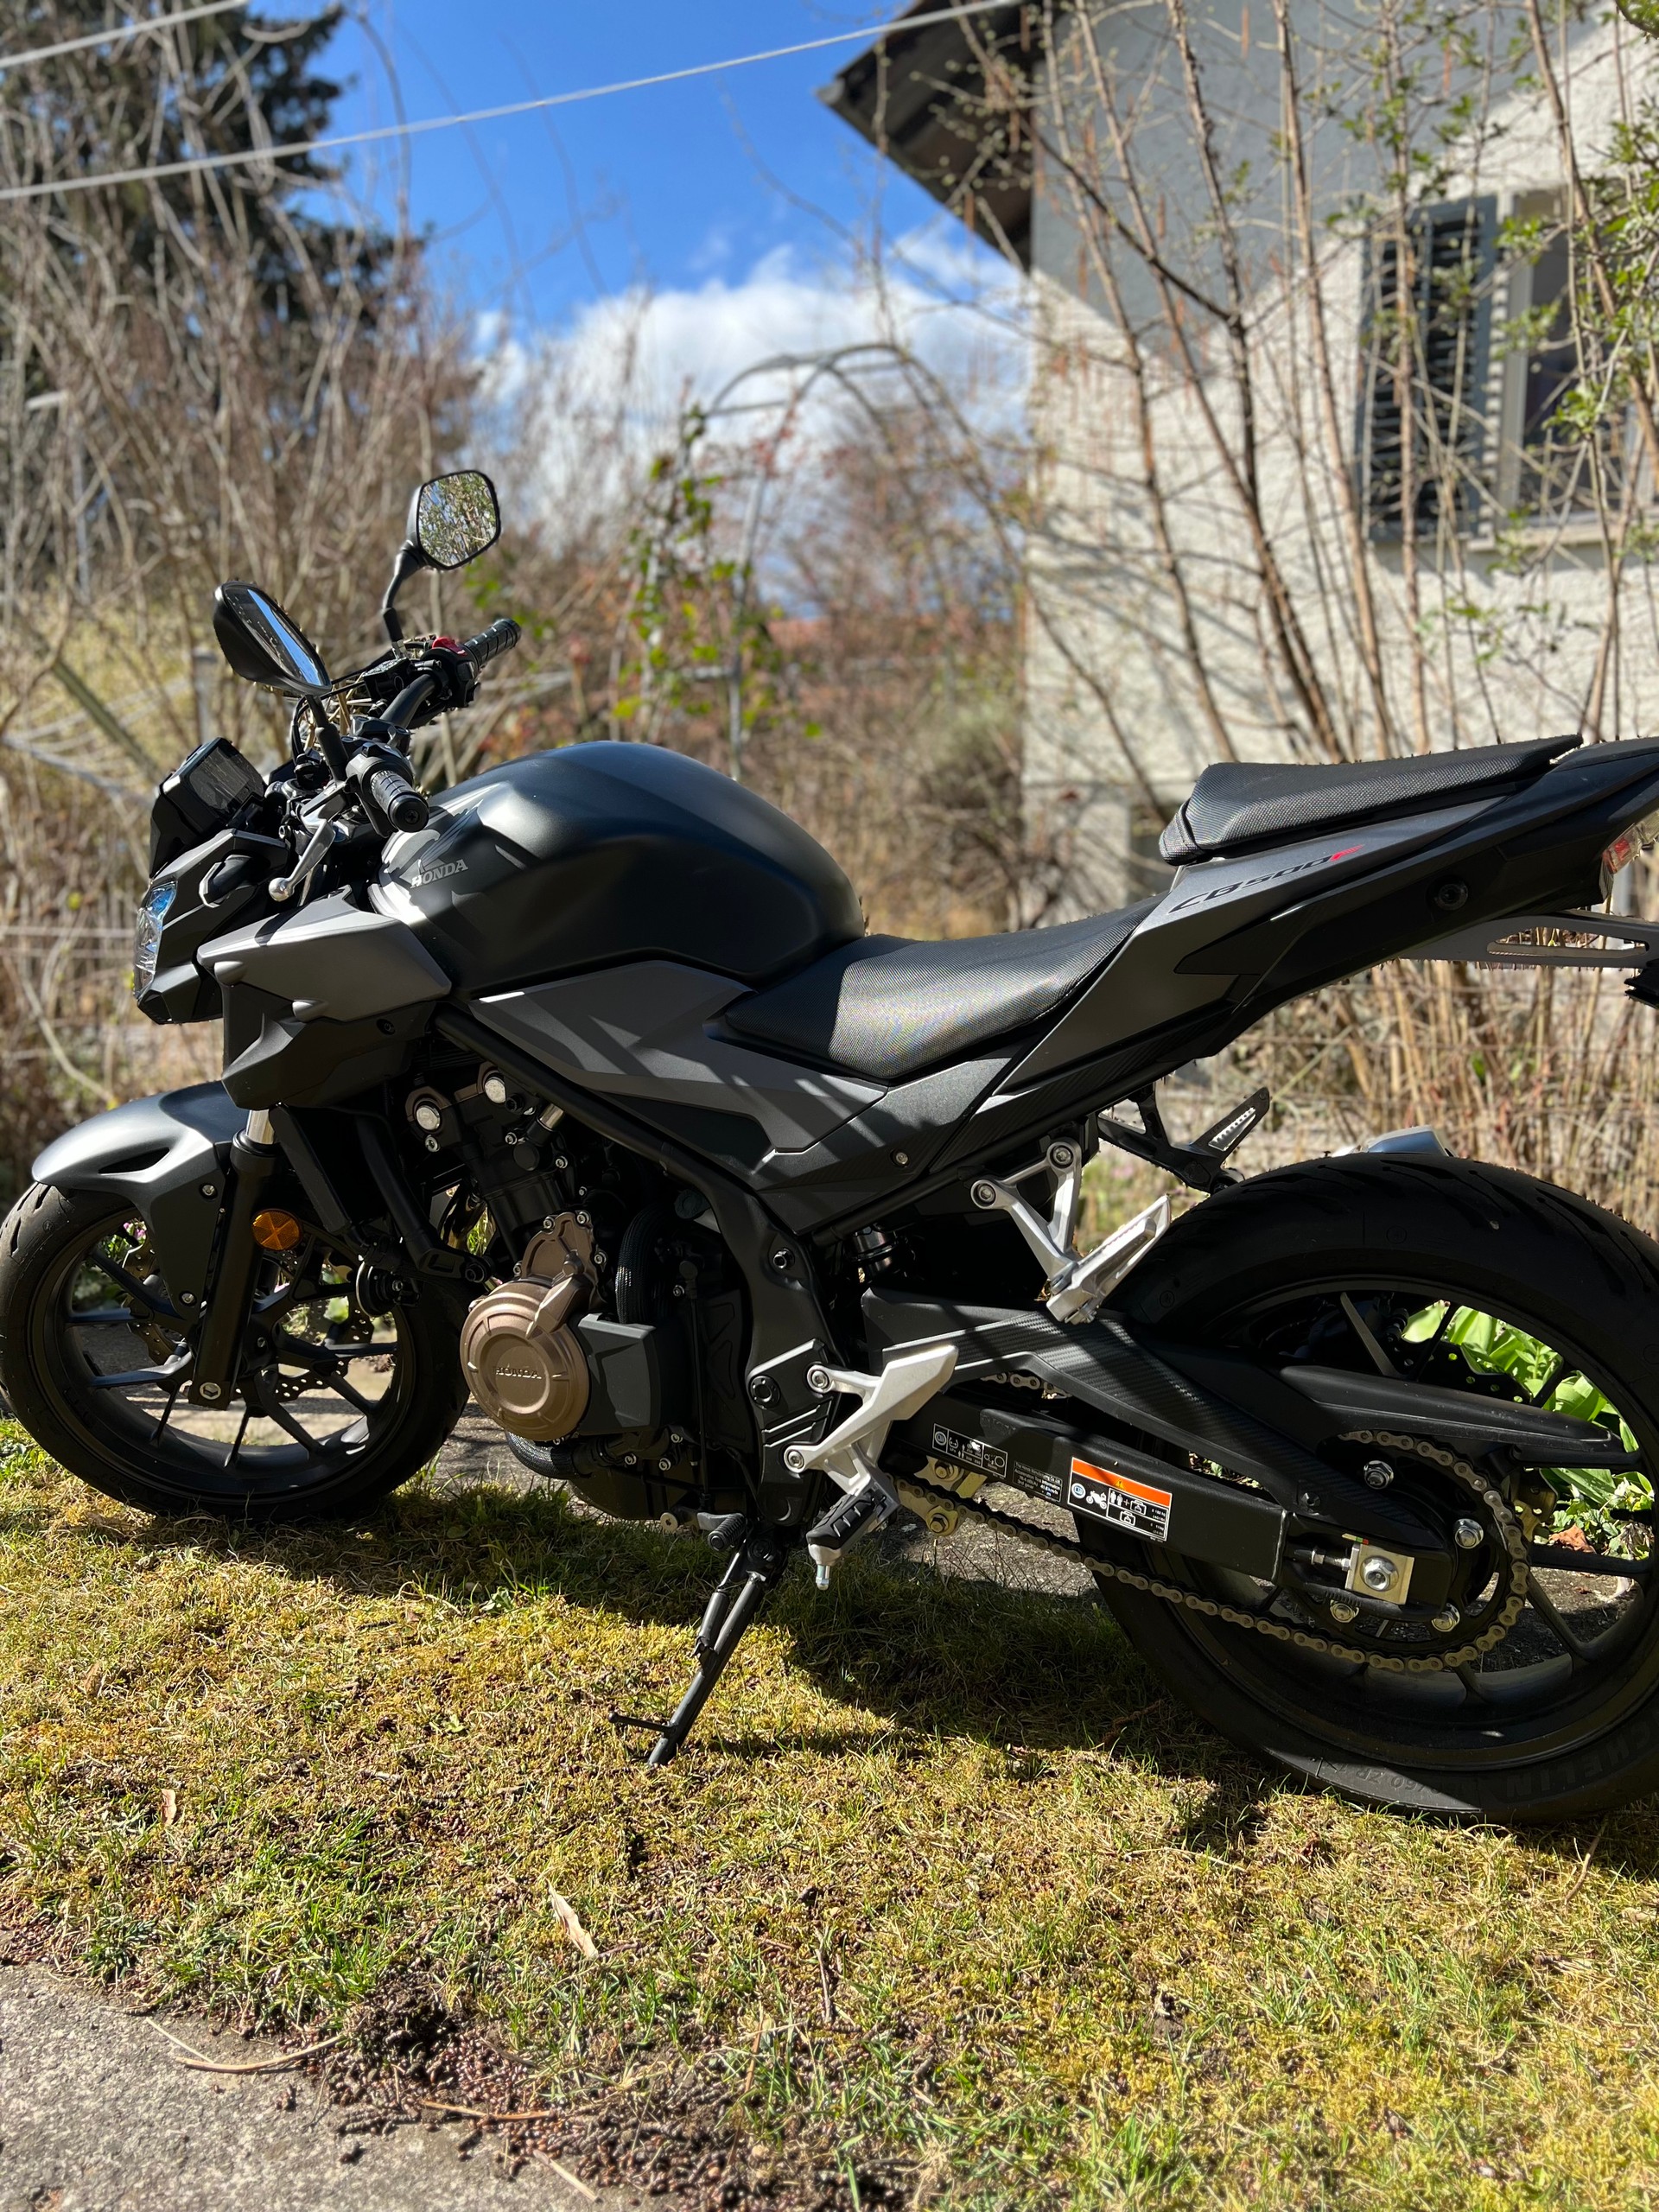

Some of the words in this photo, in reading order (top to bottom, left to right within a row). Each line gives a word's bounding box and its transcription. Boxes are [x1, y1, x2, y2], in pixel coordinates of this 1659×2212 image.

[410, 859, 468, 888] HONDA
[1168, 844, 1364, 914] CB500F
[494, 1366, 542, 1380] HONDA
